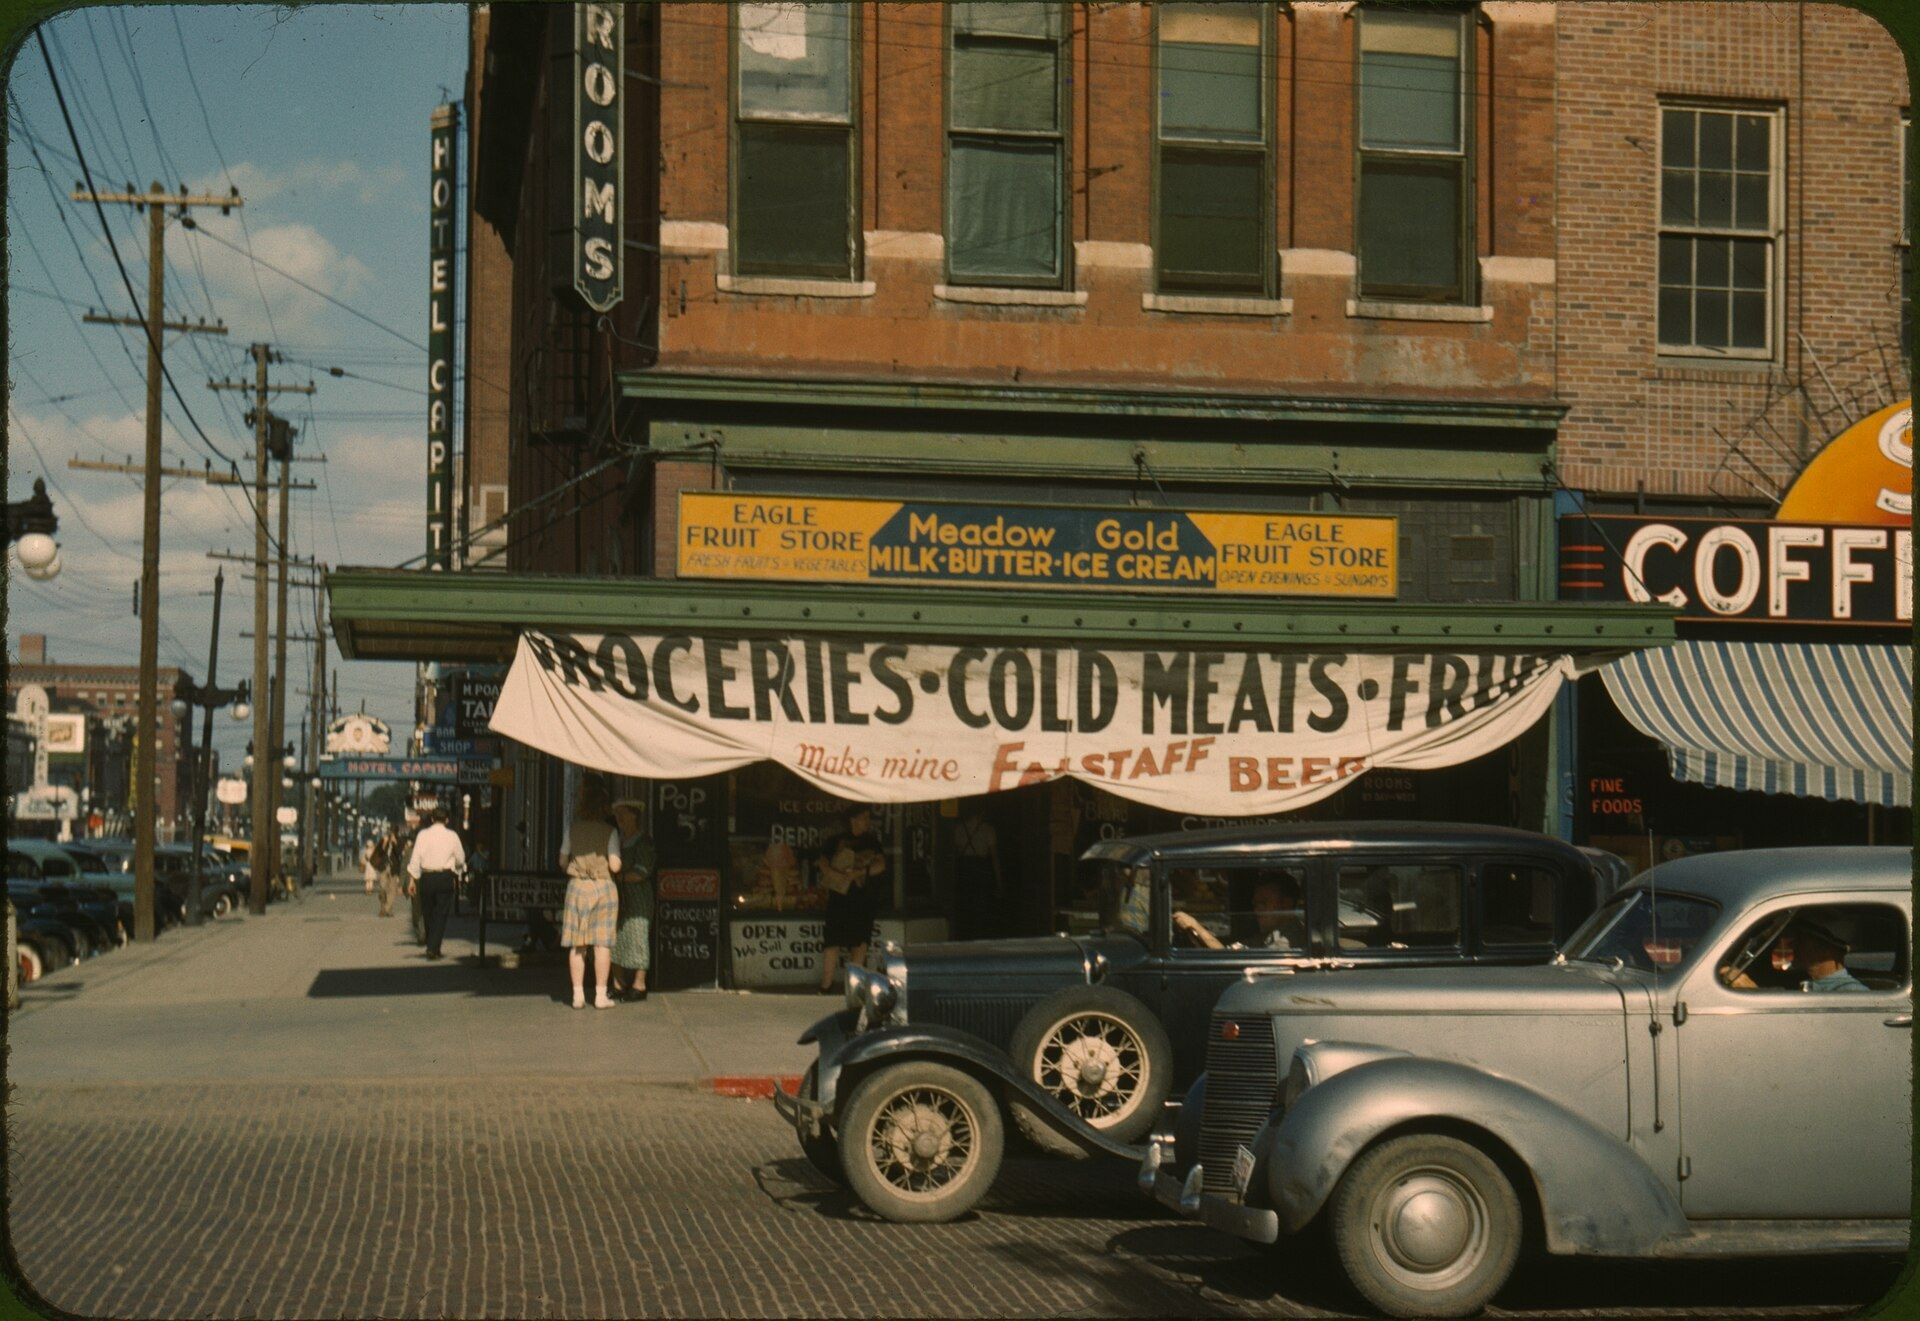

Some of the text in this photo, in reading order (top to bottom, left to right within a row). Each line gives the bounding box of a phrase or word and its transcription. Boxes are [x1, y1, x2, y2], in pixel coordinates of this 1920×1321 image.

[584, 4, 615, 281] ROOMS
[431, 136, 450, 333] HOTEL
[733, 503, 818, 526] EAGLE
[686, 526, 864, 552] FRUIT STORE
[908, 512, 1179, 552] Meadow Gold
[1265, 522, 1345, 543] EAGLE
[1221, 543, 1388, 568] FRUIT STORE
[1116, 555, 1215, 581] CREAM
[948, 646, 1118, 733] COLD
[1142, 650, 1349, 735] MEATS
[440, 741, 471, 753] SHOP
[347, 762, 396, 774] HOTEL
[799, 742, 871, 778] Make
[880, 748, 960, 782] mine
[1590, 777, 1625, 793] FINE
[779, 800, 801, 813] ICE
[1591, 798, 1643, 814] FOODS
[770, 823, 823, 848] BERR
[742, 924, 787, 940] OPEN
[769, 957, 814, 970] COLD
